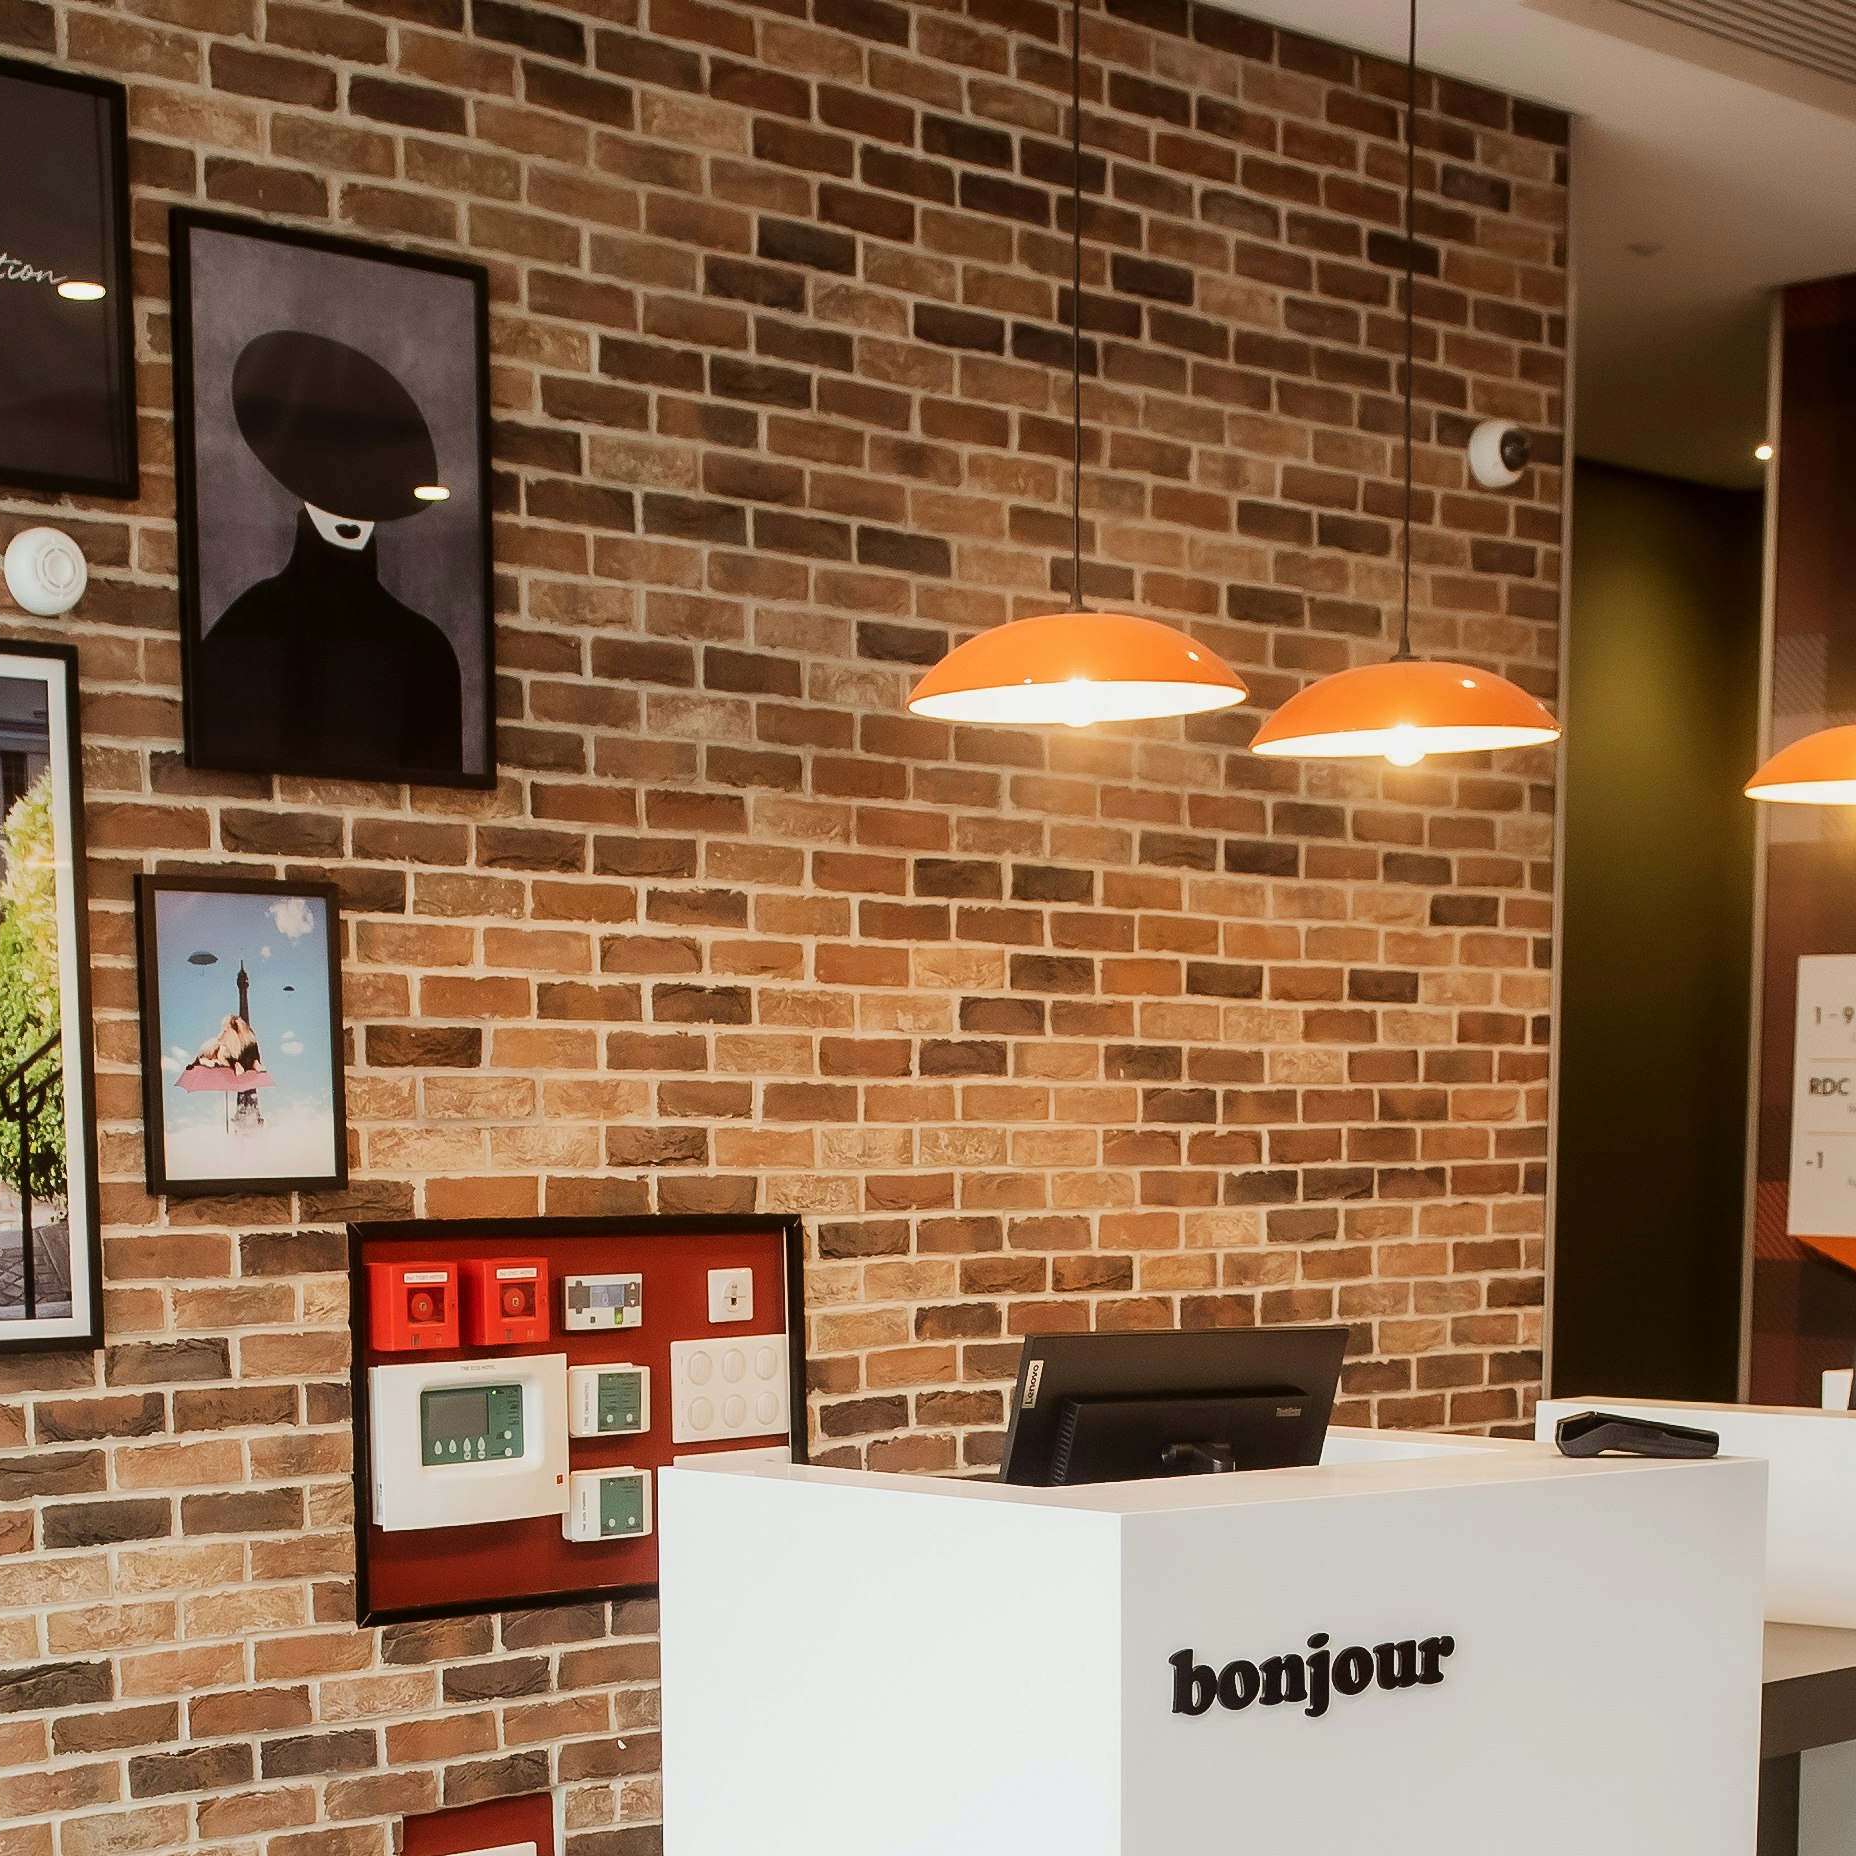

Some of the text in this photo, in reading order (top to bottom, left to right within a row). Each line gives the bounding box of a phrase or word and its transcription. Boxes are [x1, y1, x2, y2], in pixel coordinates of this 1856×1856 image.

[1808, 1077, 1851, 1097] RDC
[1805, 1151, 1824, 1169] -1
[1024, 1365, 1040, 1404] Lenovo
[1168, 1632, 1456, 1718] bonjour
